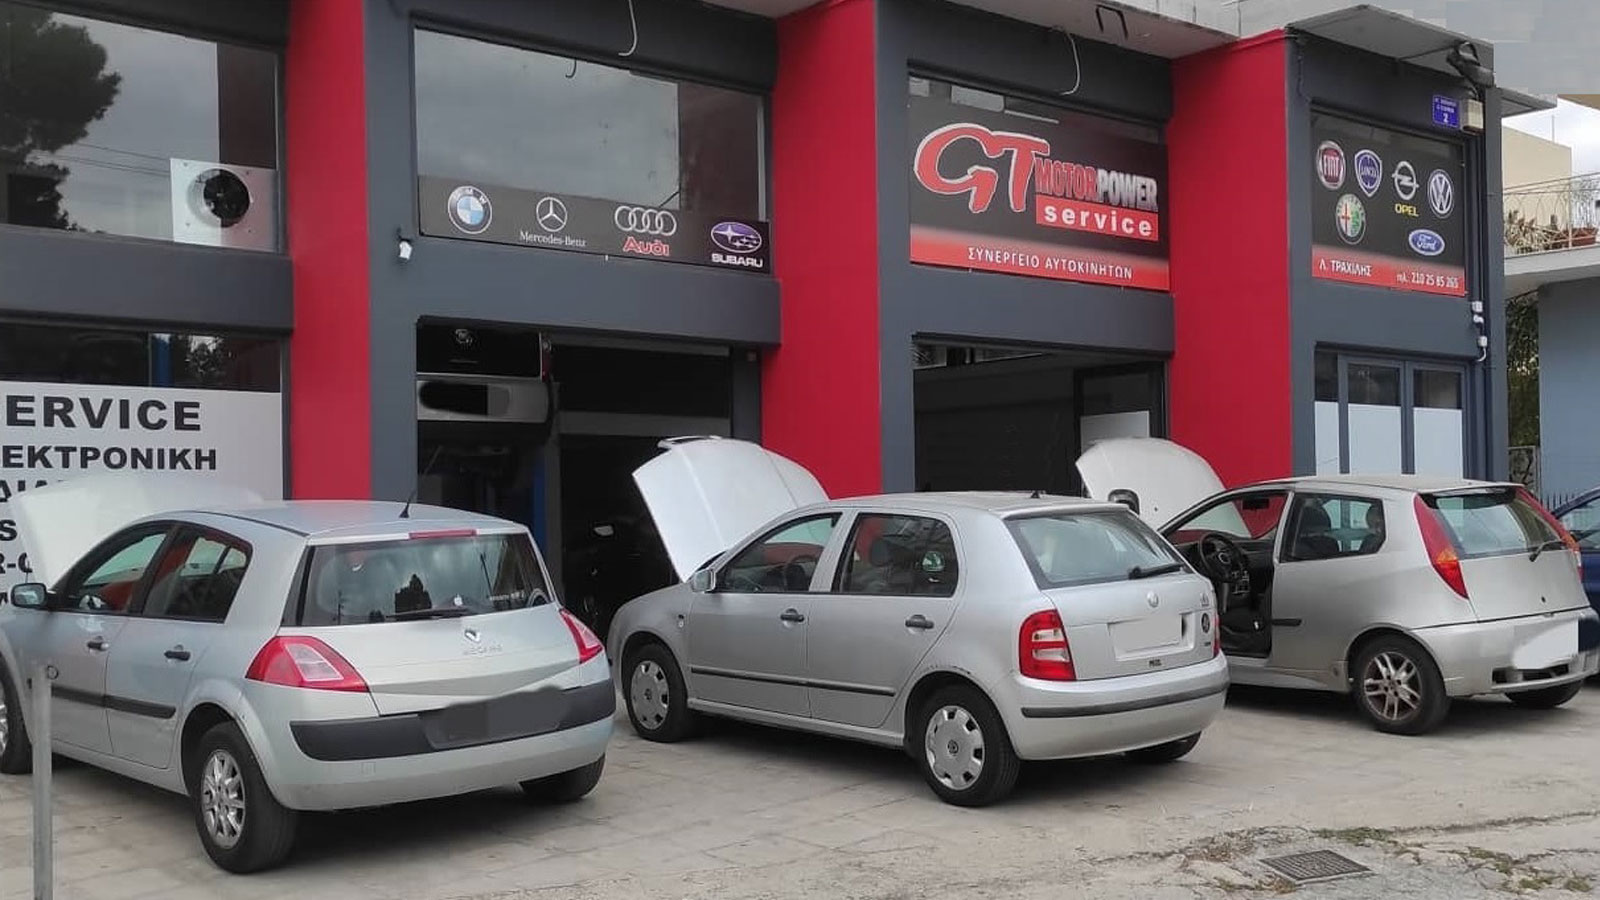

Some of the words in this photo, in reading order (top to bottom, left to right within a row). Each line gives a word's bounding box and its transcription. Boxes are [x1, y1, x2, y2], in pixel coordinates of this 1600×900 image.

[913, 122, 1050, 214] GT
[1044, 206, 1152, 236] service
[1394, 203, 1419, 217] OPEL
[519, 230, 587, 247] Mercedes-Benz
[711, 253, 764, 268] SUBARU
[968, 247, 1039, 268] ΣΥΝΕΡΓΕΙΟ
[1045, 259, 1132, 279] ΑΥΤΟΚΙΝΗΤΩΝ
